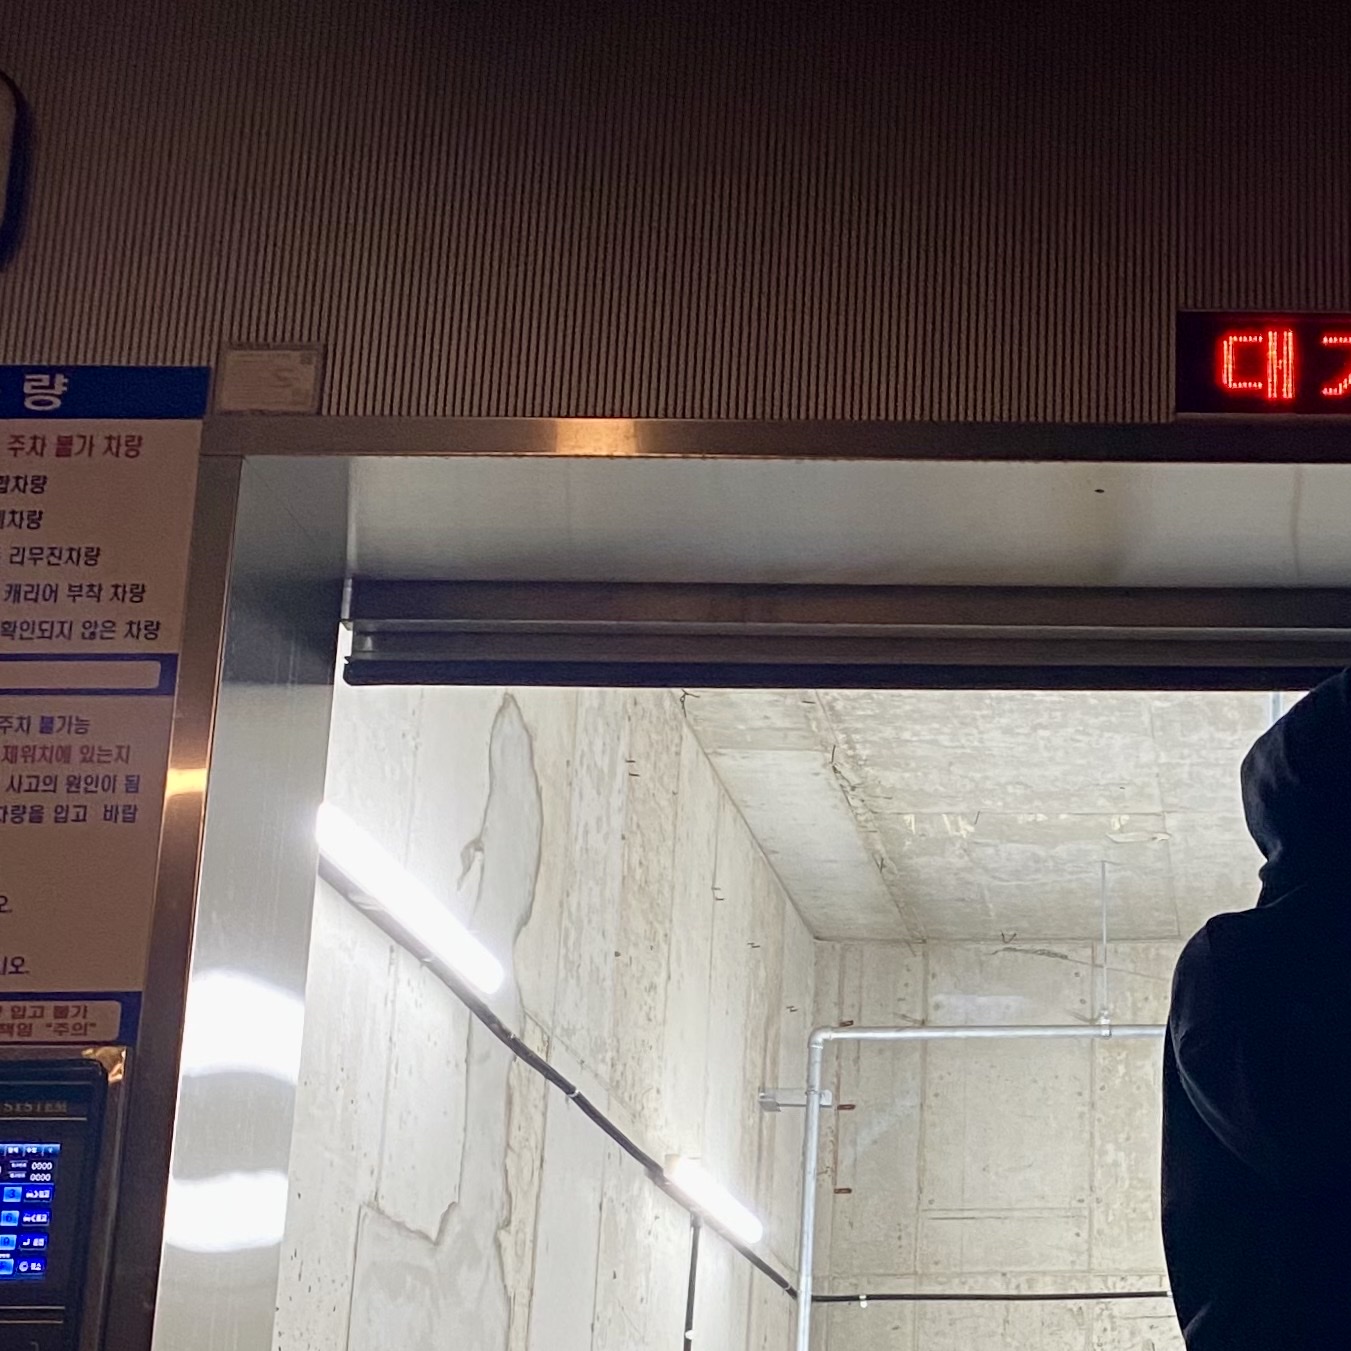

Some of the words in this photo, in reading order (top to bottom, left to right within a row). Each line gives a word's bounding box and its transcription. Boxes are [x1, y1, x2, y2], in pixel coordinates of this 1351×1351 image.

[23, 373, 69, 410] 량
[7, 434, 47, 458] 주차
[55, 434, 94, 458] 불가
[103, 434, 143, 458] 차량
[9, 546, 101, 567] 리무진차량
[5, 583, 59, 604] 캐리어
[67, 583, 103, 604] 부착
[110, 583, 146, 603] 차량
[0, 620, 73, 640] 확인되지
[81, 620, 117, 640] 않은
[125, 620, 161, 640] 차량
[39, 715, 90, 735] 불가능
[79, 744, 131, 764] 있는지
[6, 774, 57, 795] 사고의
[65, 774, 117, 794] 원인이
[124, 774, 140, 793] 됨
[54, 804, 87, 823] 입고
[103, 804, 138, 823] 바람
